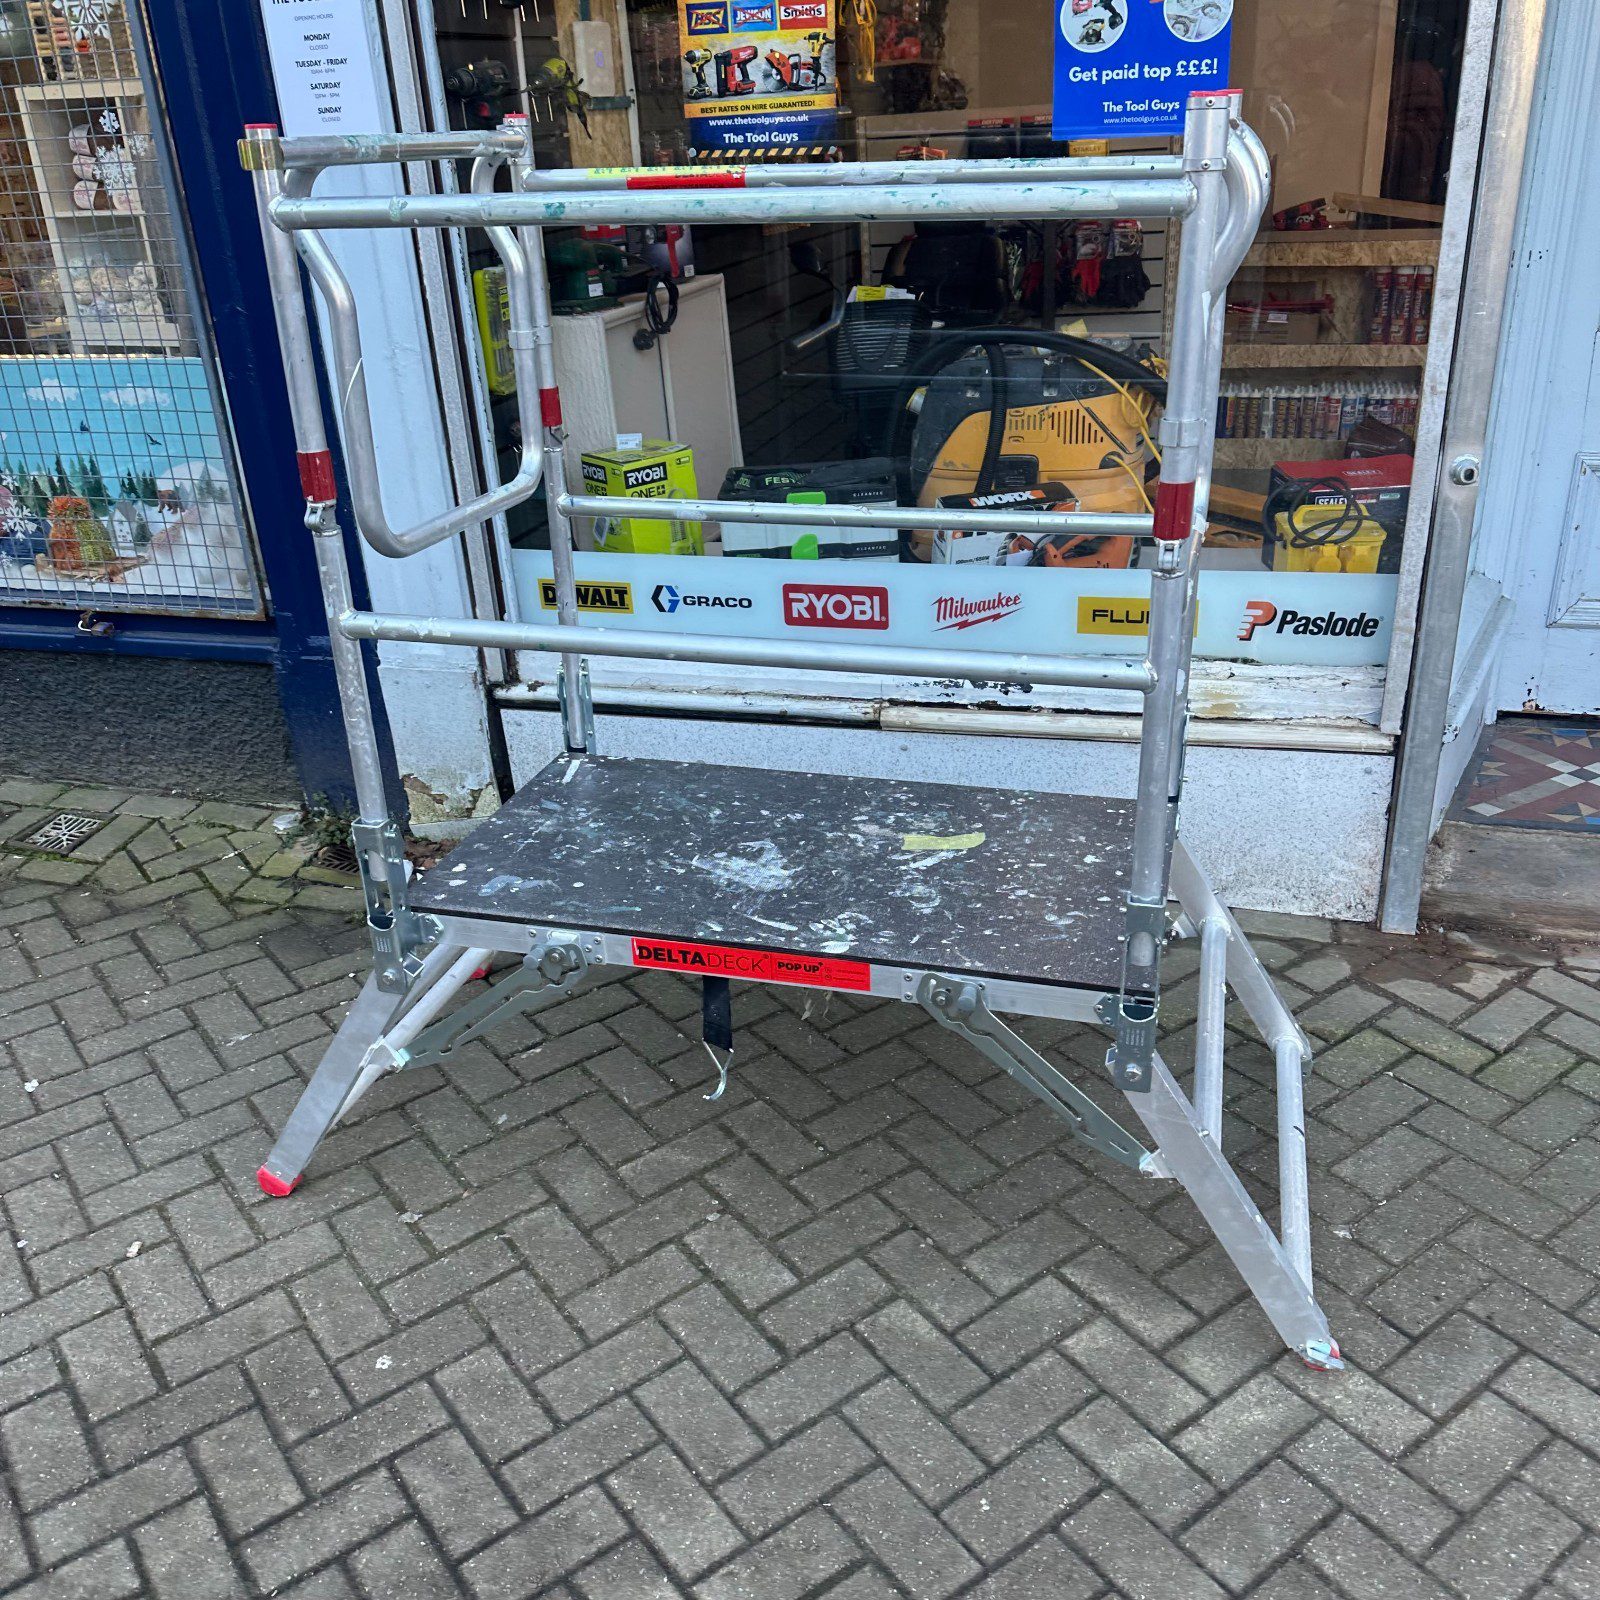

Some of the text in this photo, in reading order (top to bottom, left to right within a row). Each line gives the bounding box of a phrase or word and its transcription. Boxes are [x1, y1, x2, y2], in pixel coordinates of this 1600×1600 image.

[784, 4, 823, 18] Smiths
[303, 33, 331, 41] MONDAY
[295, 60, 321, 68] TUESDAY
[326, 58, 348, 66] FRIDAY
[1069, 57, 1218, 84] Get paid top £££!
[310, 82, 341, 90] SATURDAY
[317, 106, 342, 114] SUNDAY
[700, 106, 717, 114] BEST
[718, 105, 739, 113] RATES
[769, 100, 816, 109] GUARANTEED!
[1103, 99, 1180, 112] The Tool Guys
[708, 113, 809, 127] www.thetoolguys.co.uk
[1103, 114, 1178, 124] www.thetoolguys.co.uk
[723, 131, 799, 144] The Tool Guys
[582, 464, 606, 482] RYOBI
[626, 465, 666, 486] RYOBI
[970, 490, 1037, 507] WORX
[543, 585, 628, 608] DWALT
[682, 595, 753, 609] GRACO
[788, 592, 881, 622] RYOBI
[931, 591, 1022, 623] Milwaukee
[1091, 609, 1150, 624] FLU
[1277, 608, 1380, 638] Paslode
[637, 944, 766, 974] DELTADECK
[777, 961, 820, 974] POP UP
